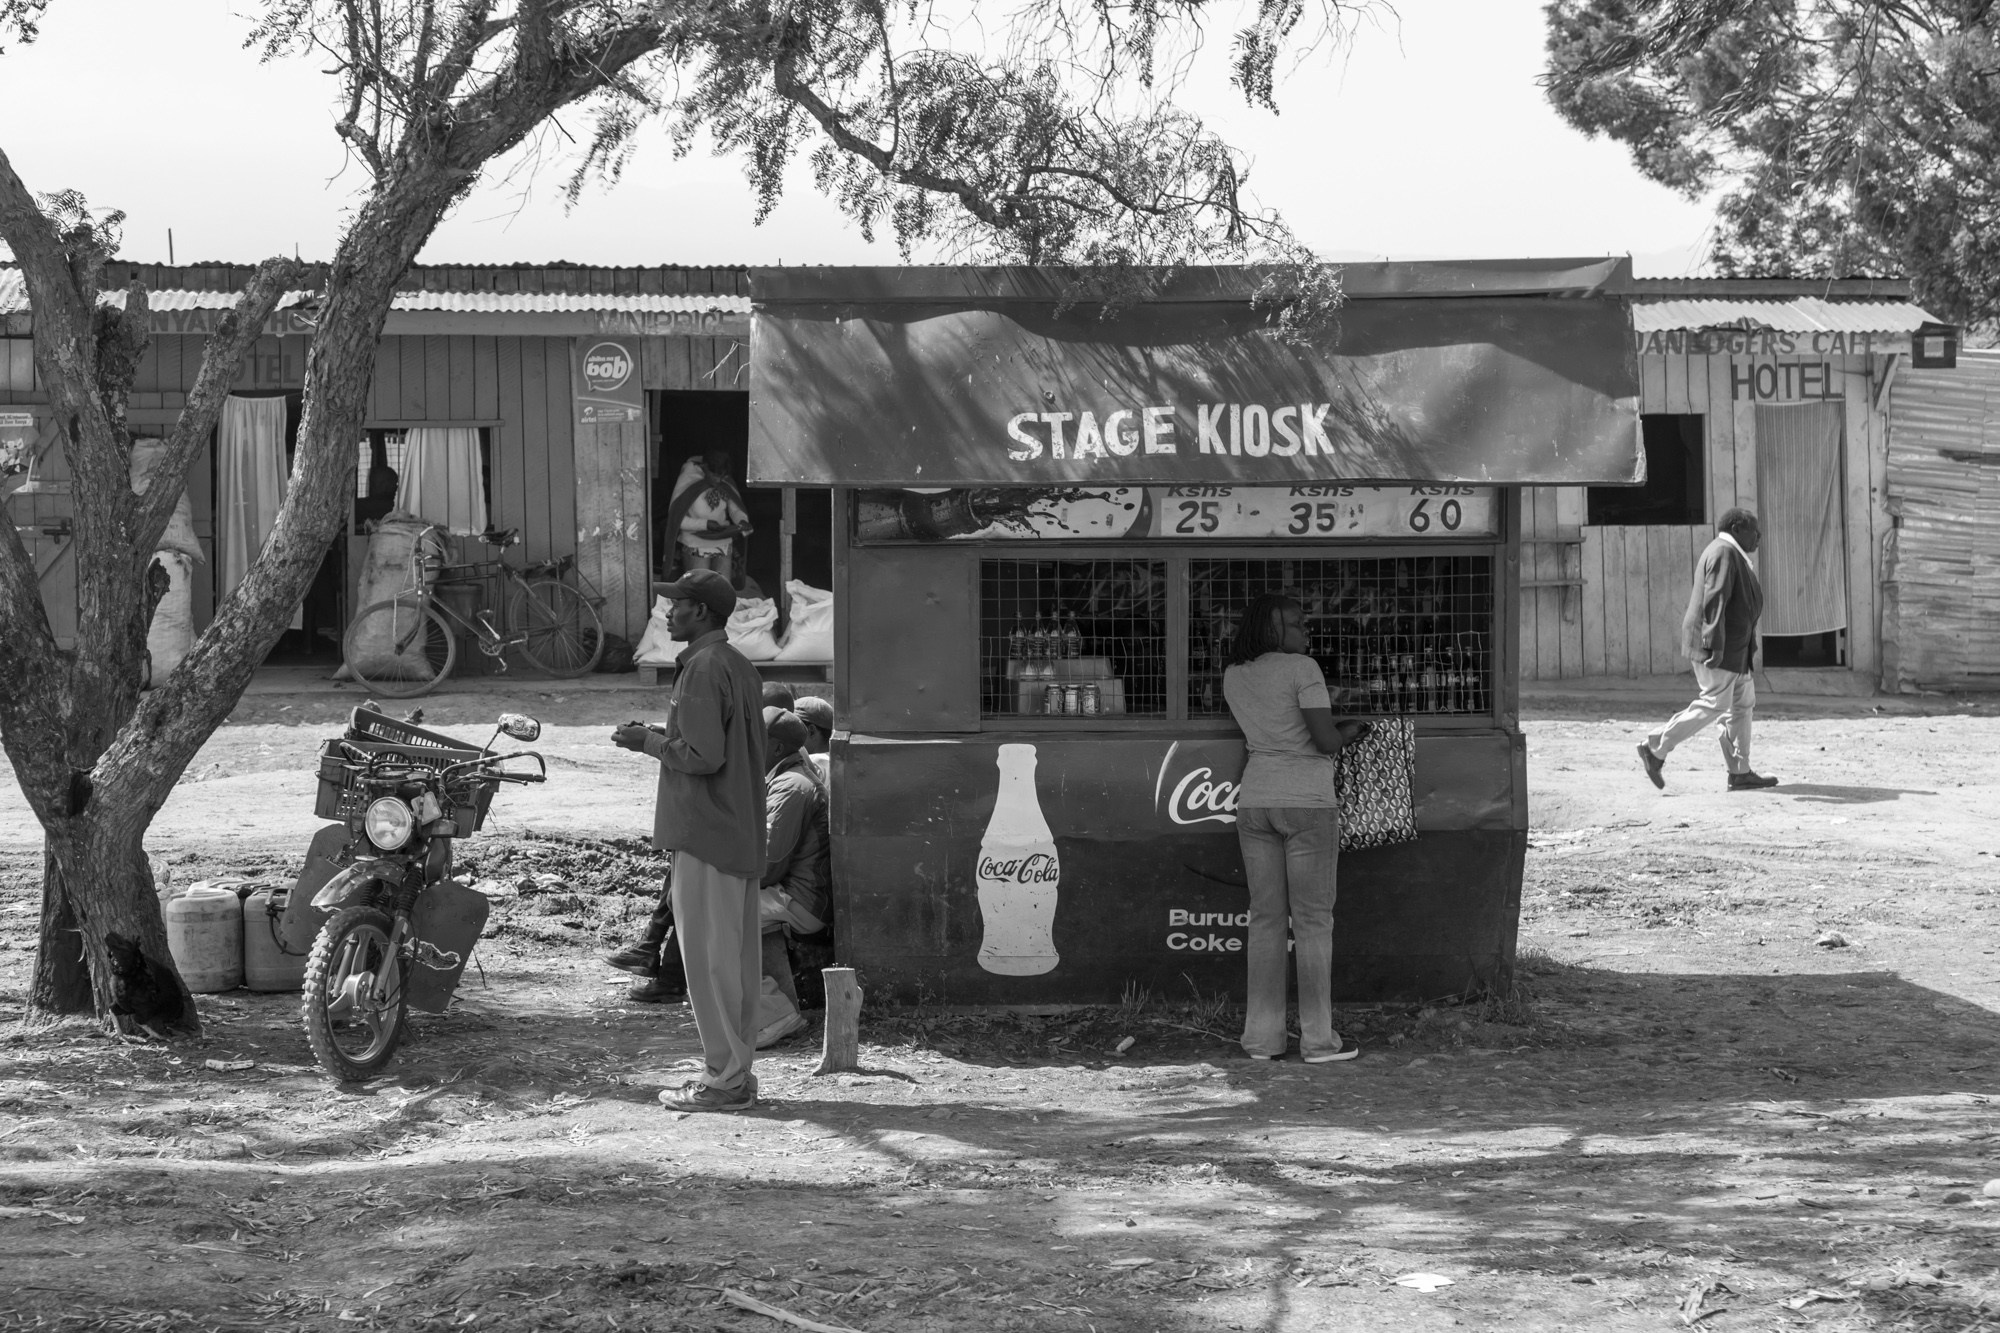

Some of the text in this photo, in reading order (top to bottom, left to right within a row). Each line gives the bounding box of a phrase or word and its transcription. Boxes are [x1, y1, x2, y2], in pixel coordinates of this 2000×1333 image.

[587, 356, 627, 379] bob
[1731, 362, 1846, 401] HOTEL
[1006, 402, 1335, 461] STAGE KIOSK
[1175, 498, 1462, 535] 25 35 60
[978, 853, 1059, 884] Coca-Cola
[1166, 932, 1243, 952] Coke
